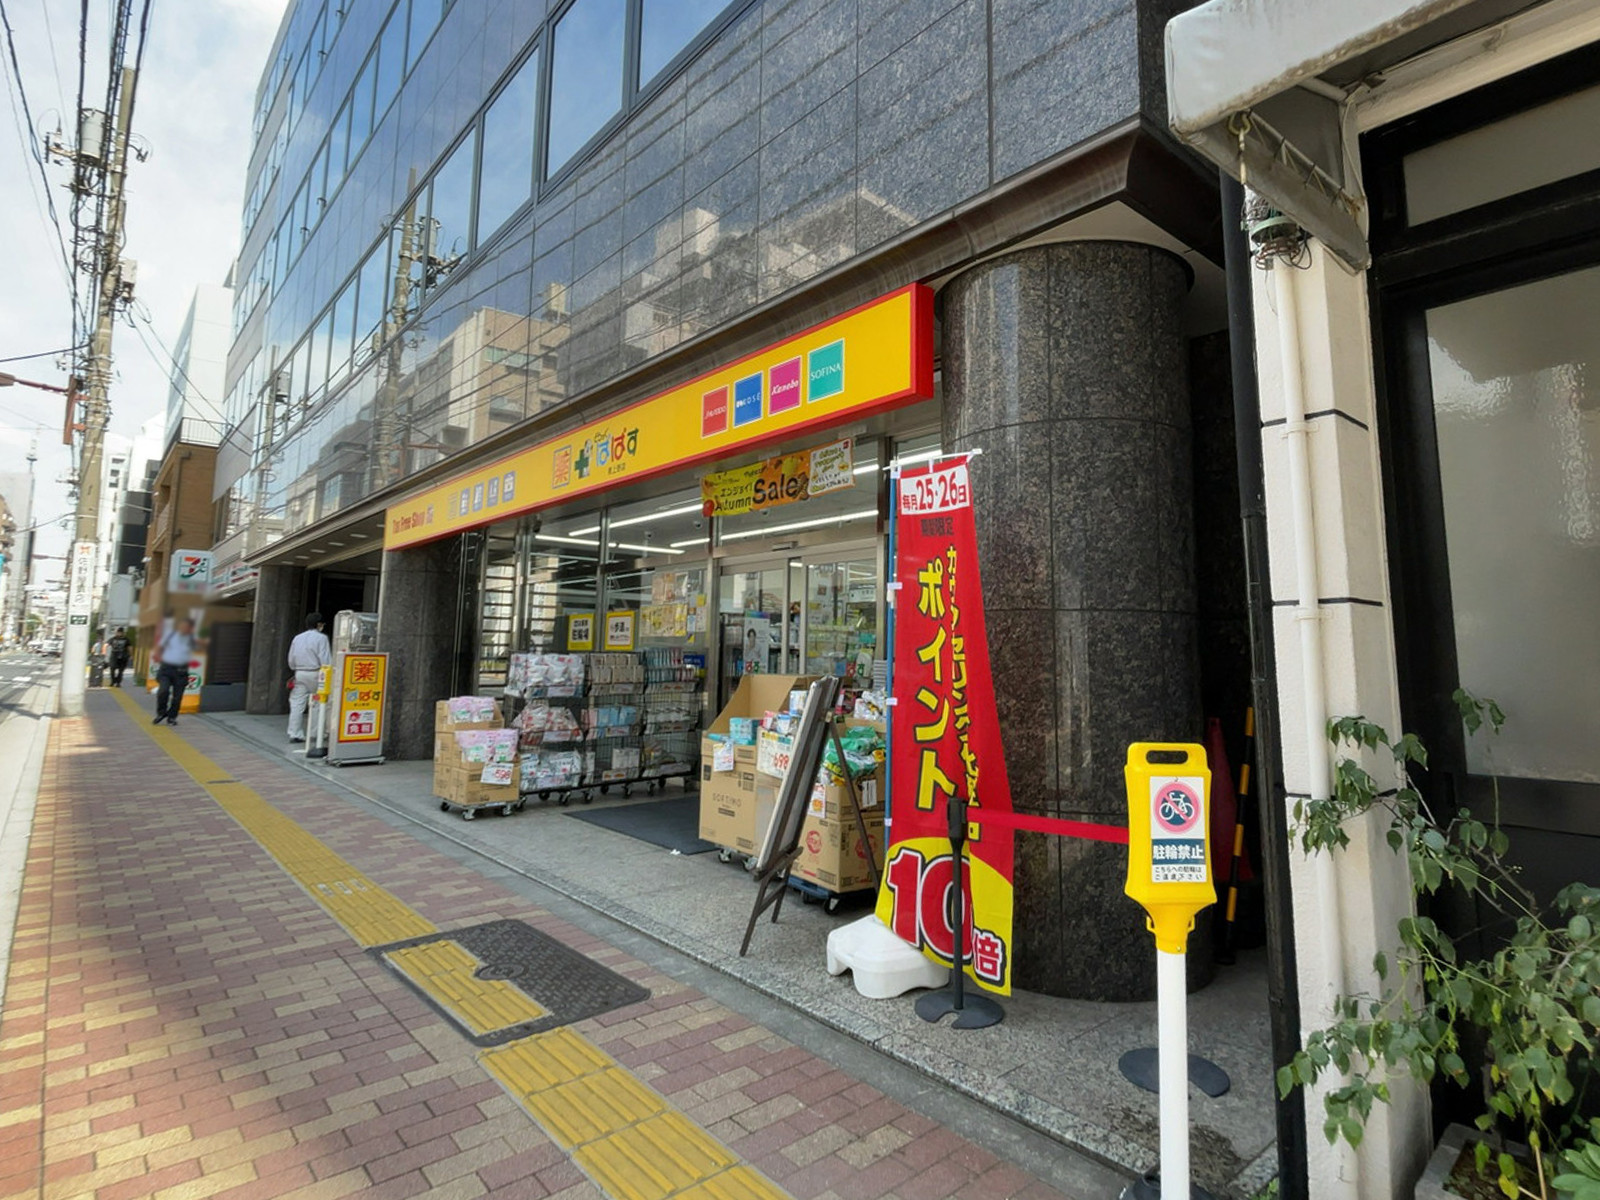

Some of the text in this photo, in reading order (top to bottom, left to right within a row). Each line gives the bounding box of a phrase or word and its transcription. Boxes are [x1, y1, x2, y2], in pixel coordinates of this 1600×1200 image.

[811, 363, 842, 381] SOFINA
[772, 380, 799, 396] Kanebo
[753, 474, 800, 504] Sale
[353, 662, 376, 682] 薬
[915, 557, 957, 811] ポイント
[1153, 844, 1204, 860] 駐輪禁止
